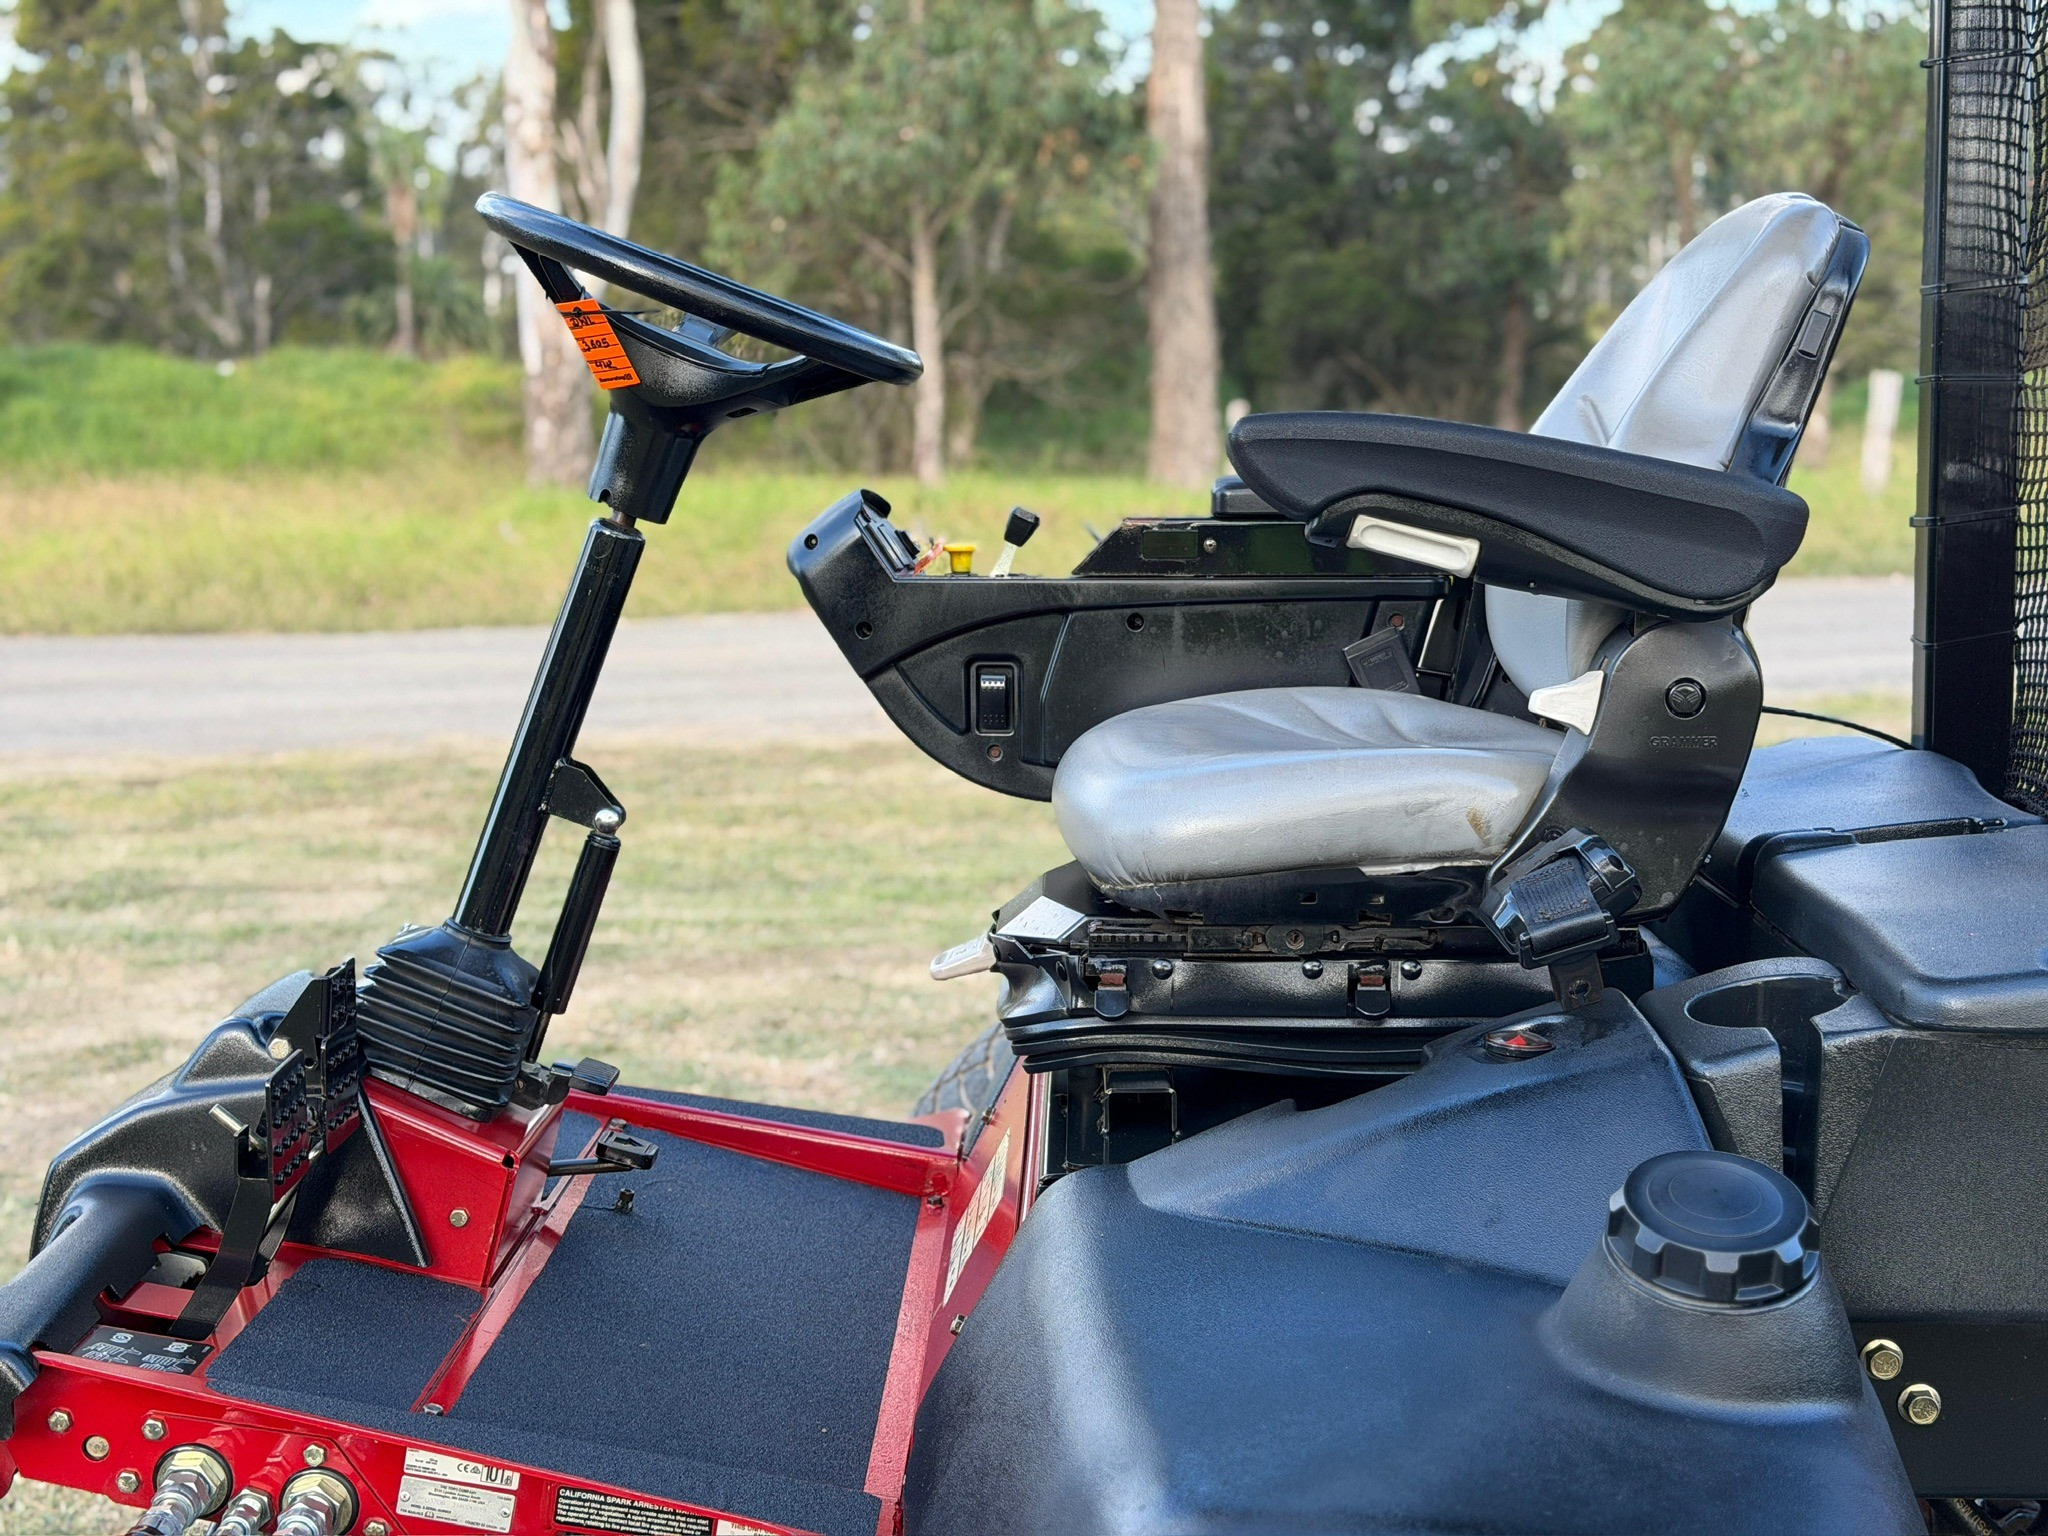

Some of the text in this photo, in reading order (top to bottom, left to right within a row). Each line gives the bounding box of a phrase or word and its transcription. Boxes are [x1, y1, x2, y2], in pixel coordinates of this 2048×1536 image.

[558, 1498, 584, 1506] Operation
[559, 1489, 605, 1502] CALIFORNIA
[606, 1496, 632, 1506] SPARK
[1954, 1498, 1974, 1516] MS
